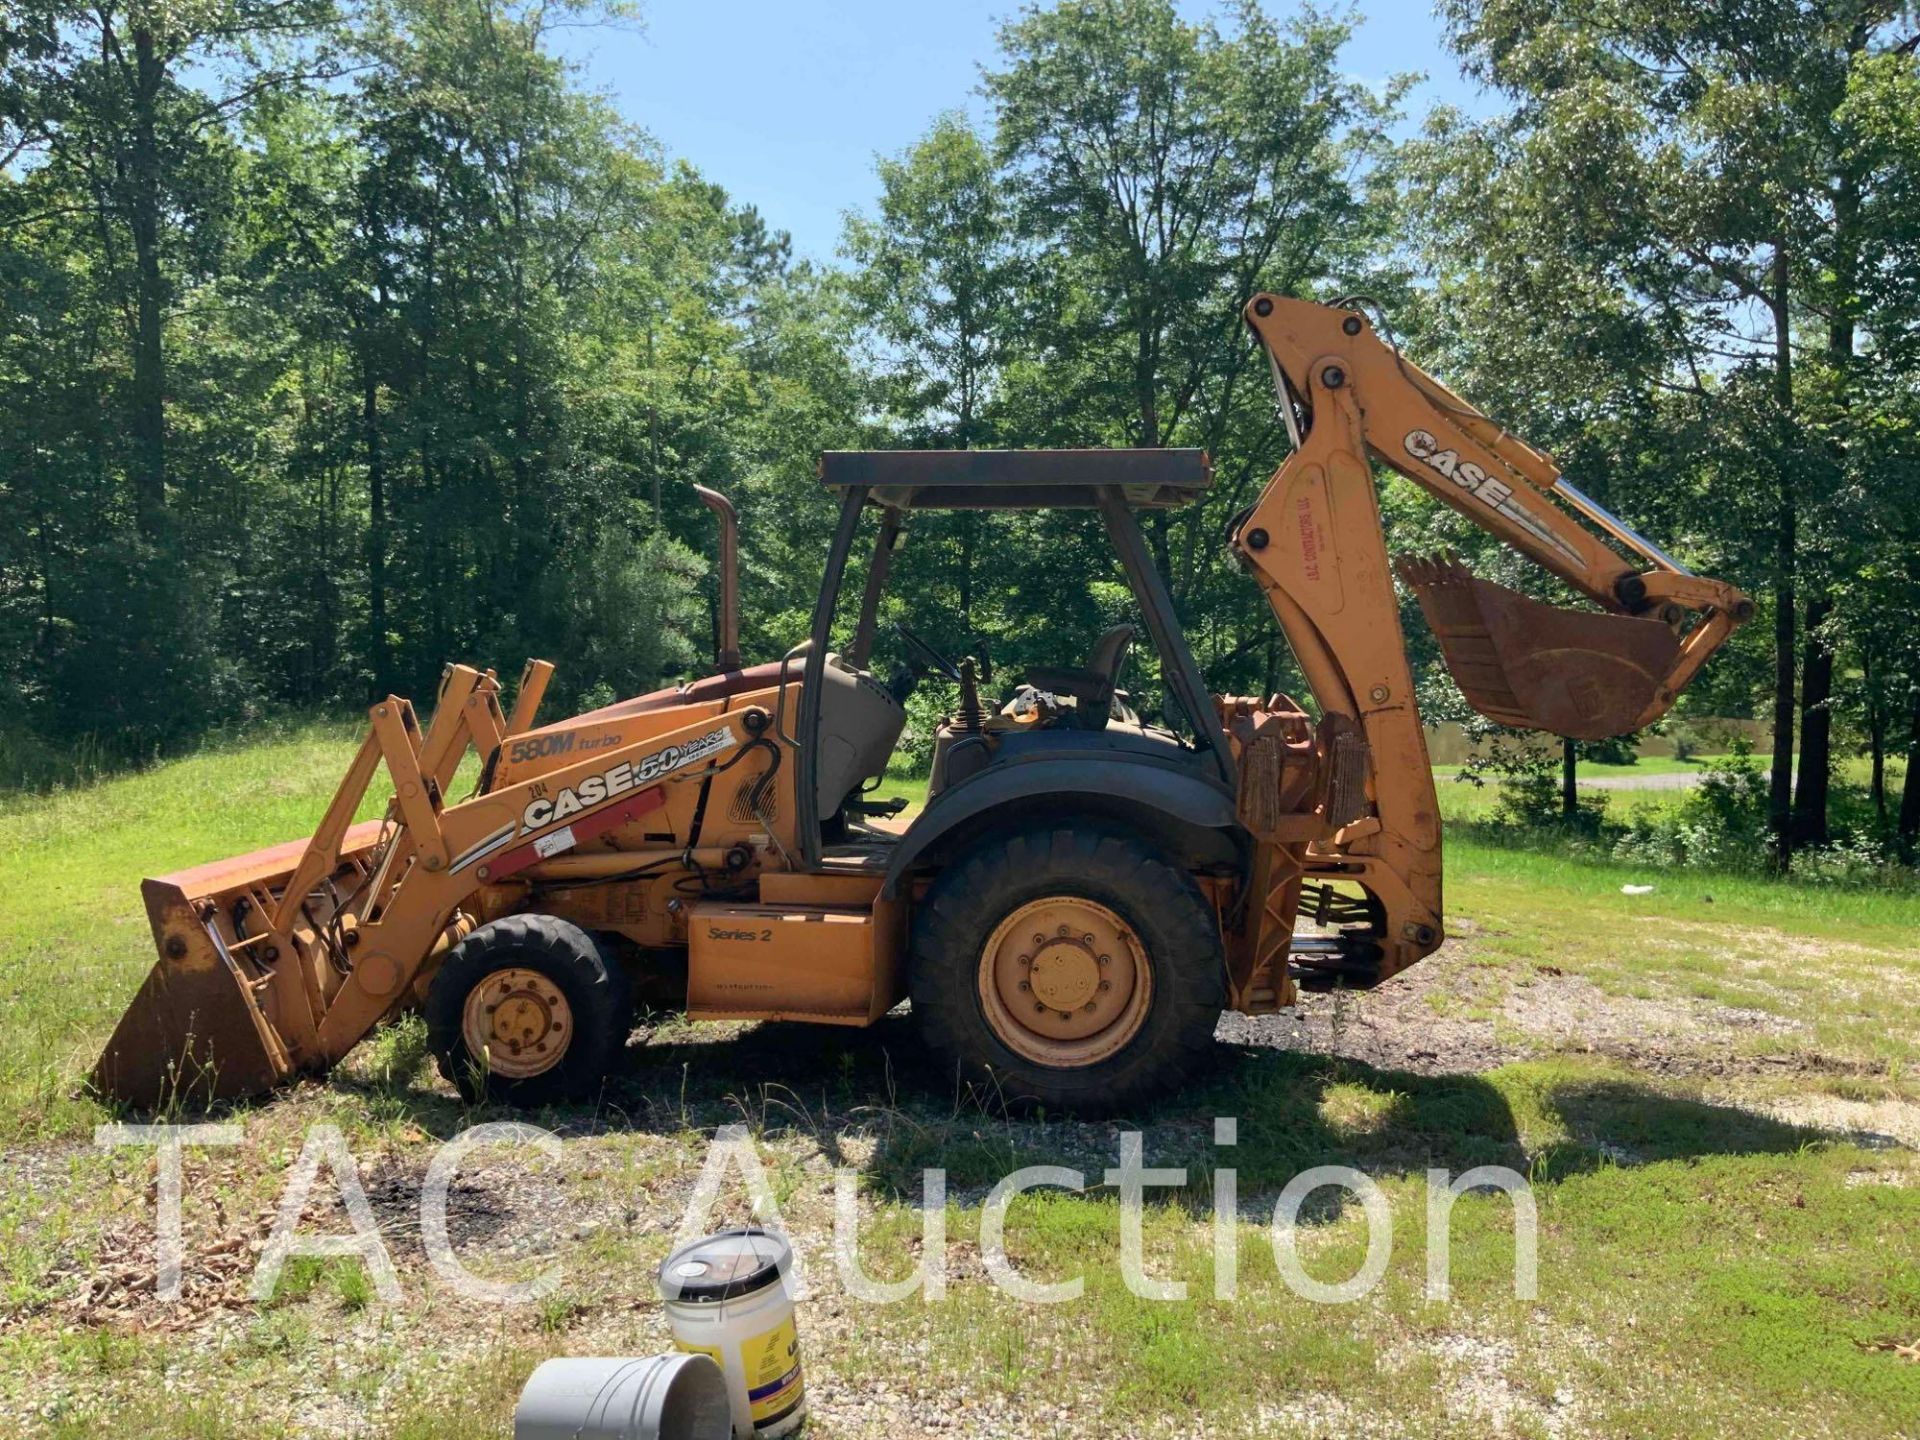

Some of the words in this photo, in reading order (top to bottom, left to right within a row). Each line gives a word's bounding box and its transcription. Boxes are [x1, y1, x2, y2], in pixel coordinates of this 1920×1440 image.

[1403, 428, 1514, 511] CASE
[510, 732, 576, 763] 580M
[578, 734, 622, 750] turbo
[523, 760, 635, 830] CASE
[638, 745, 681, 781] 50
[681, 727, 724, 757] YEARS
[527, 782, 549, 799] 204
[707, 927, 758, 942] Series
[760, 928, 773, 942] 2
